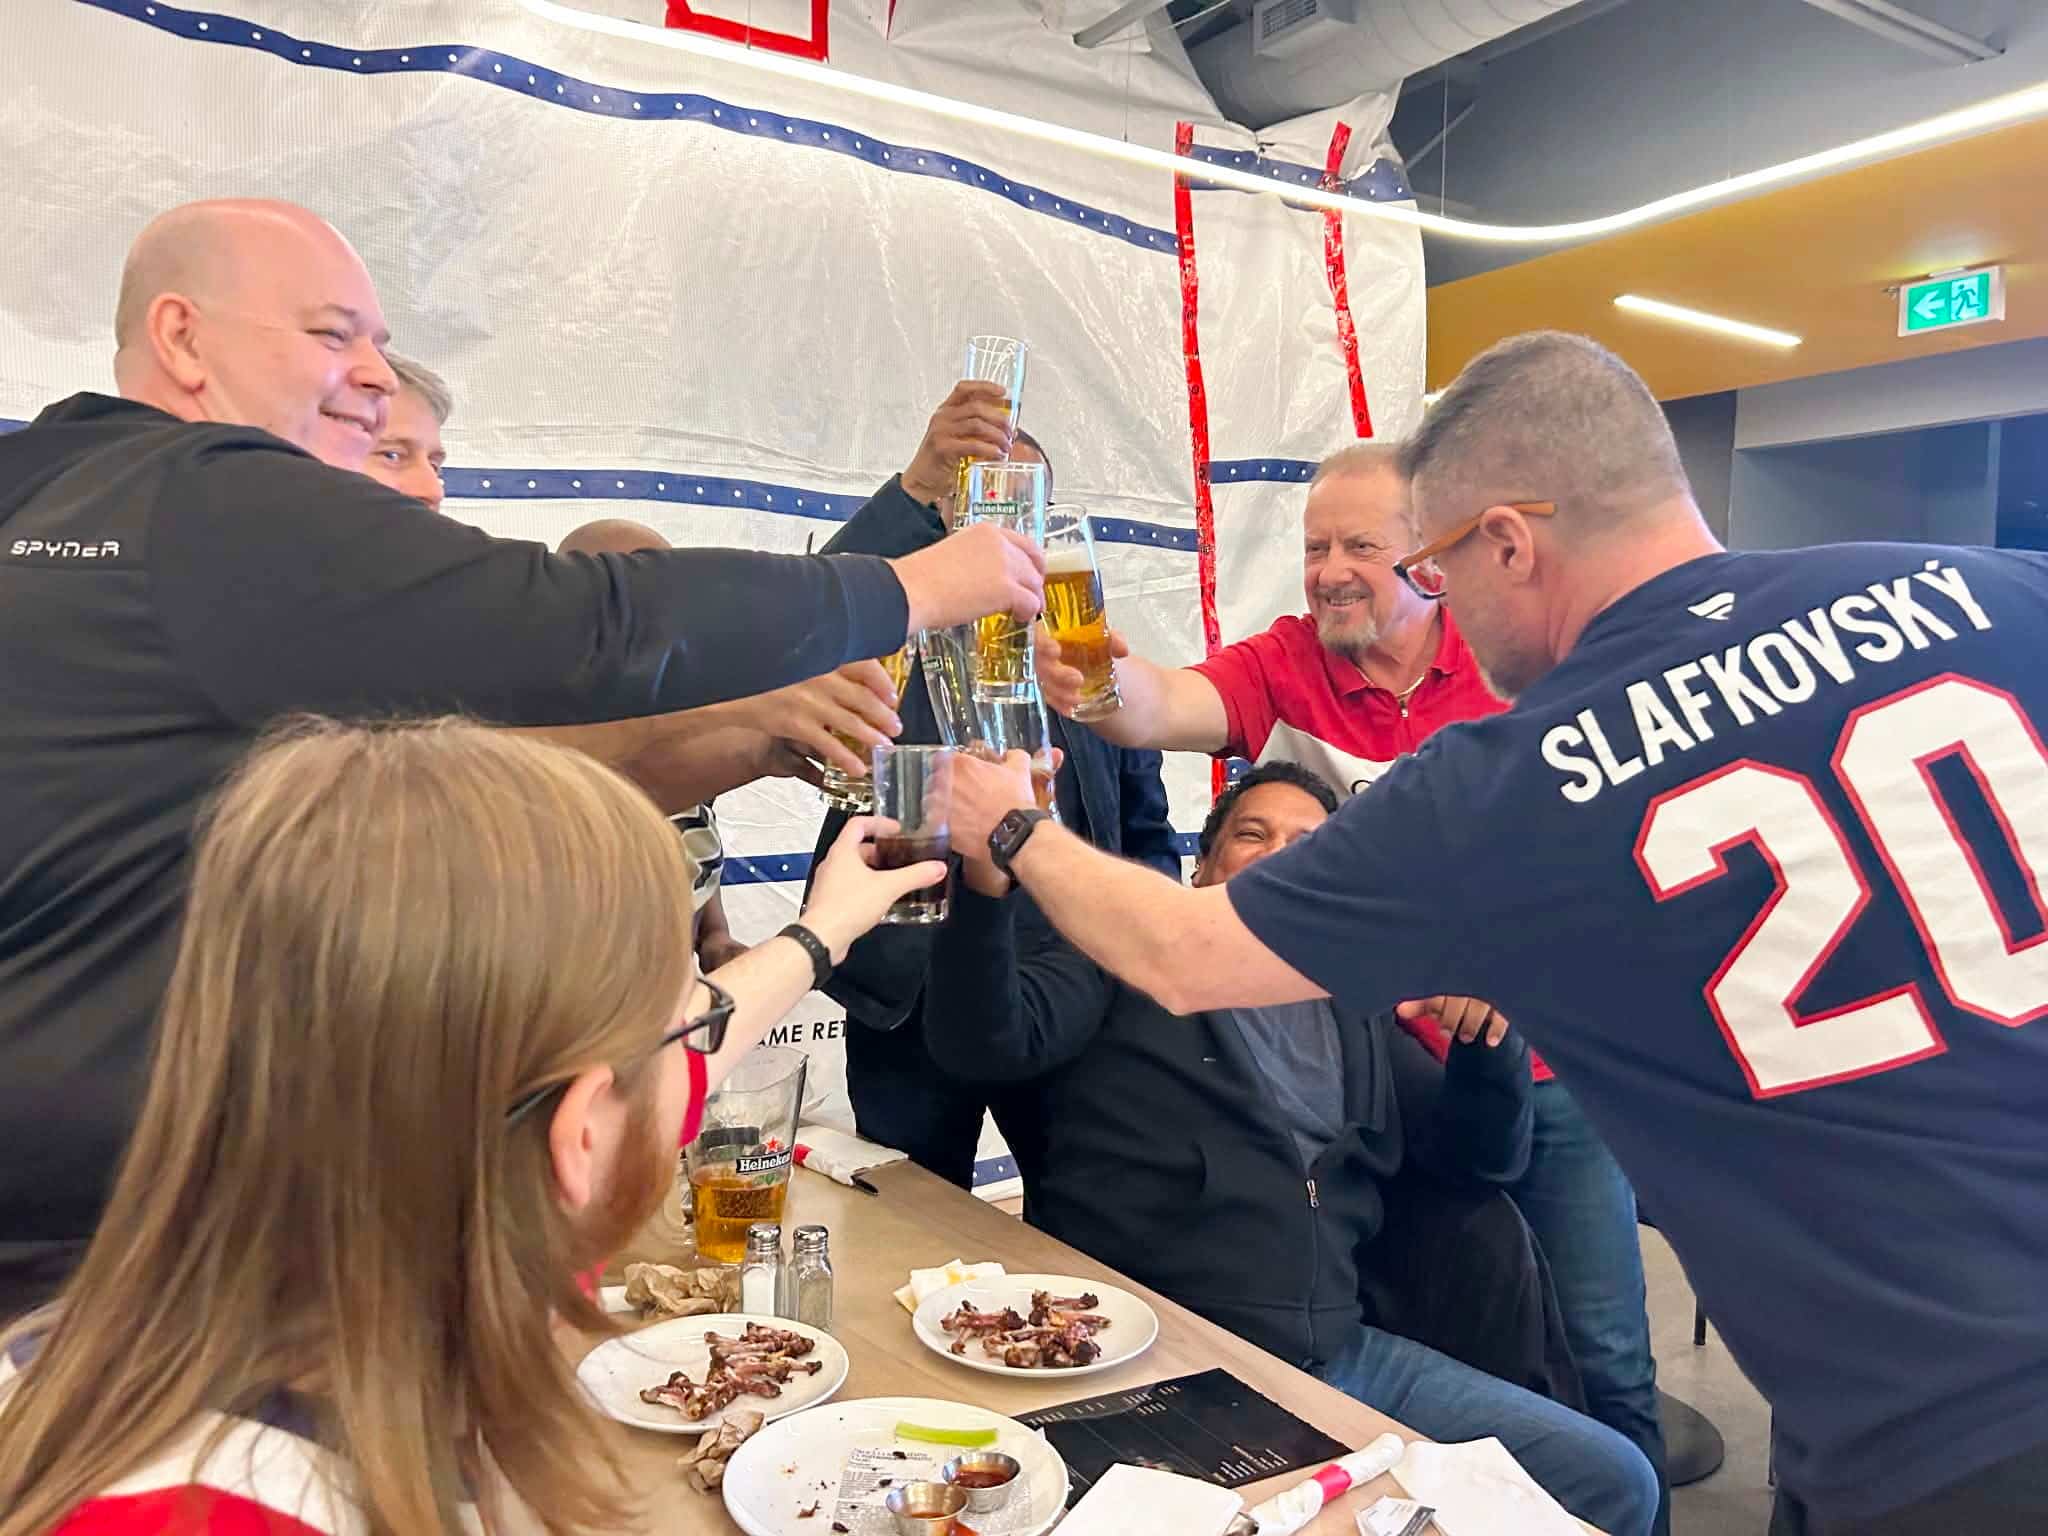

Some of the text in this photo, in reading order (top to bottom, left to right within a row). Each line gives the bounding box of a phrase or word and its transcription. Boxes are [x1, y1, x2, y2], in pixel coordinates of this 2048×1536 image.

[10, 540, 120, 558] SPYDER
[974, 504, 1016, 514] ineken
[1540, 559, 1992, 804] SLAFKOVSKÝ
[1632, 671, 2048, 1101] 20
